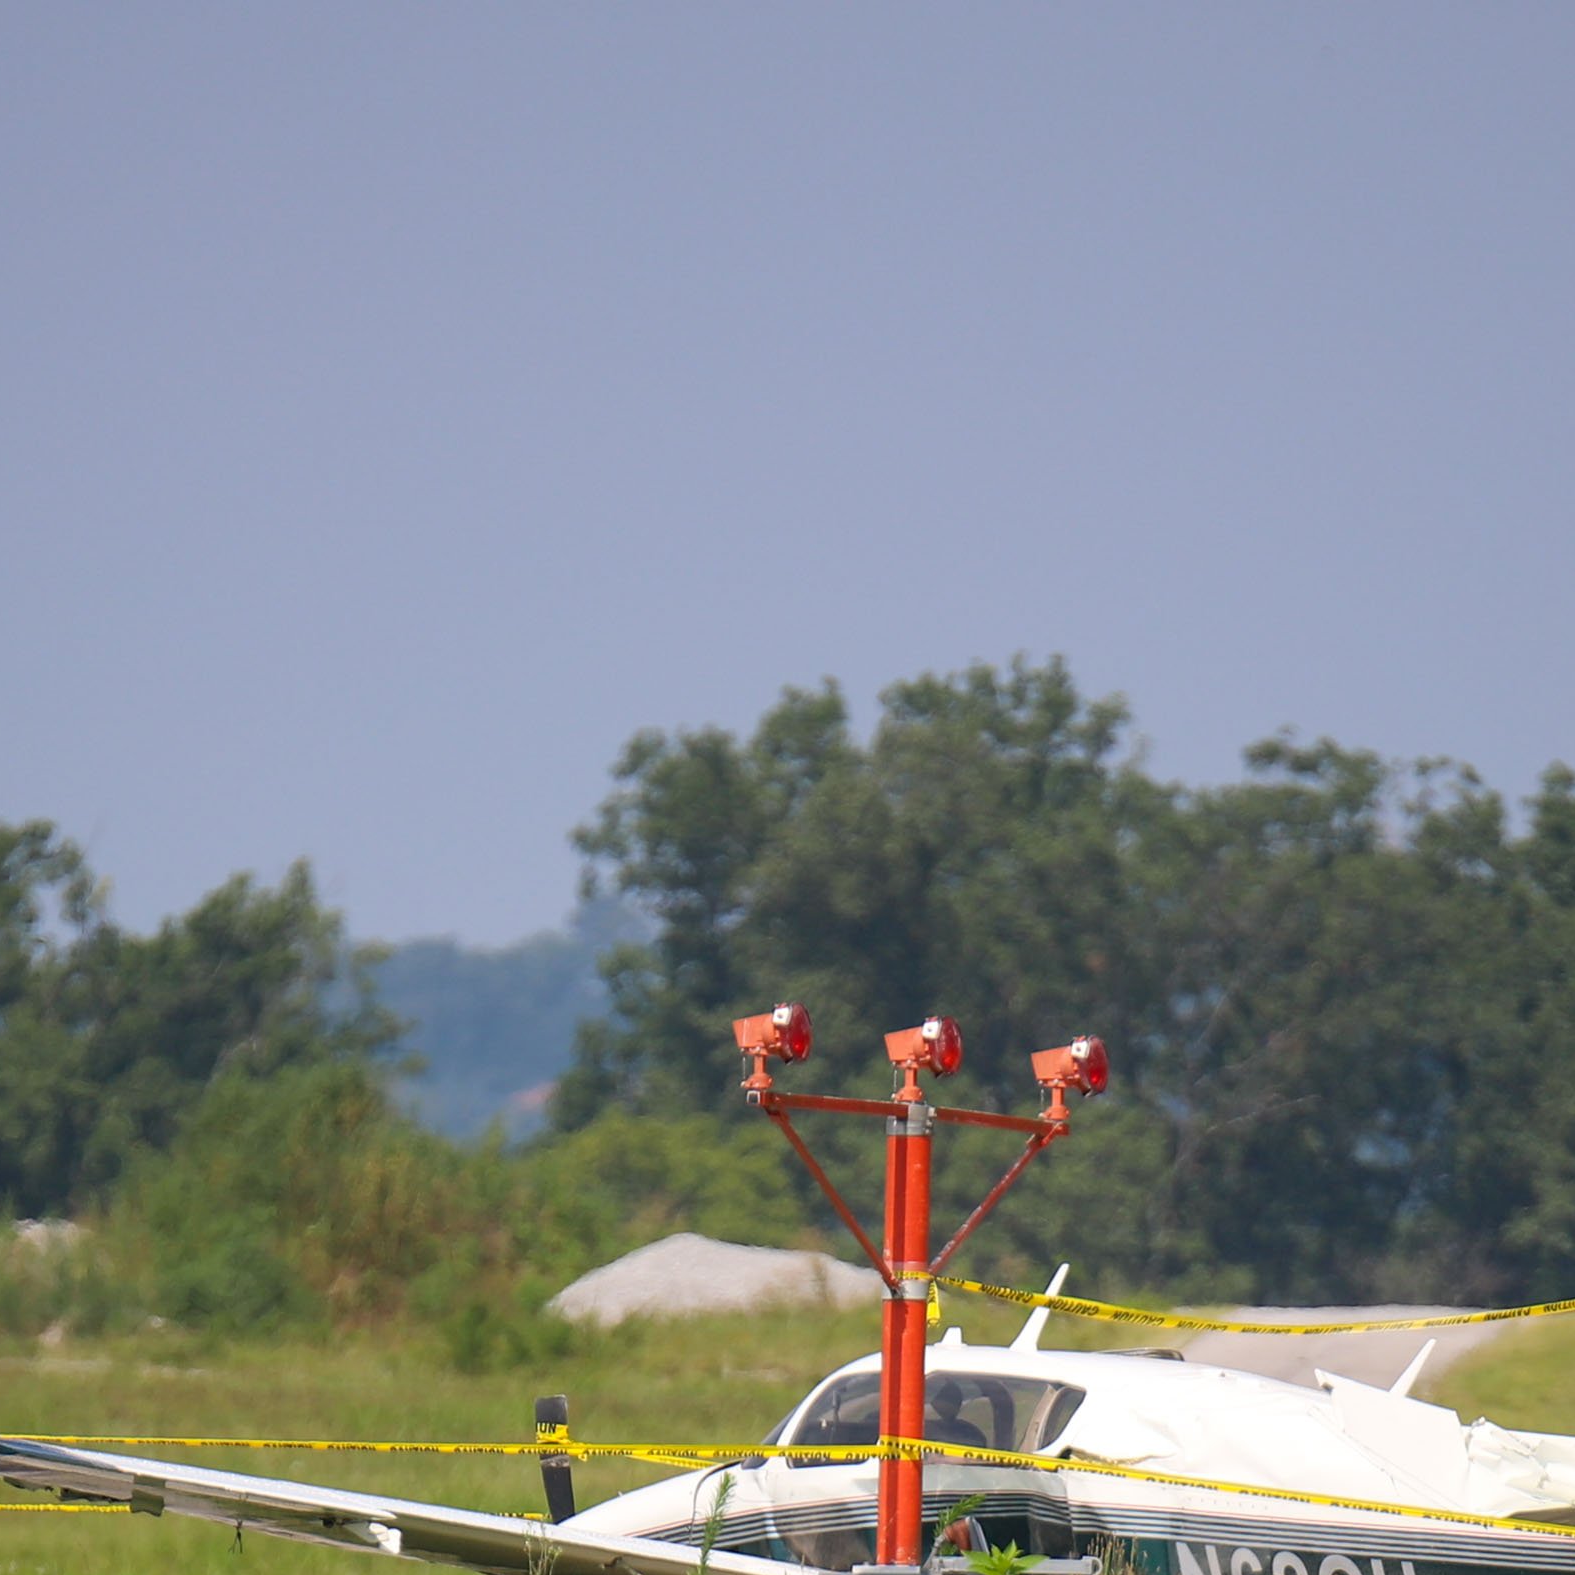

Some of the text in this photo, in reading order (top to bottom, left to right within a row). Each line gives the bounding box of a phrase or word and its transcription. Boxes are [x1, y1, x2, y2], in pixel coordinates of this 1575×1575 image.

[1045, 1298, 1100, 1316] CAUTION
[778, 1451, 901, 1461] CAUTION CAUTION
[963, 1451, 1035, 1467] CAUTION
